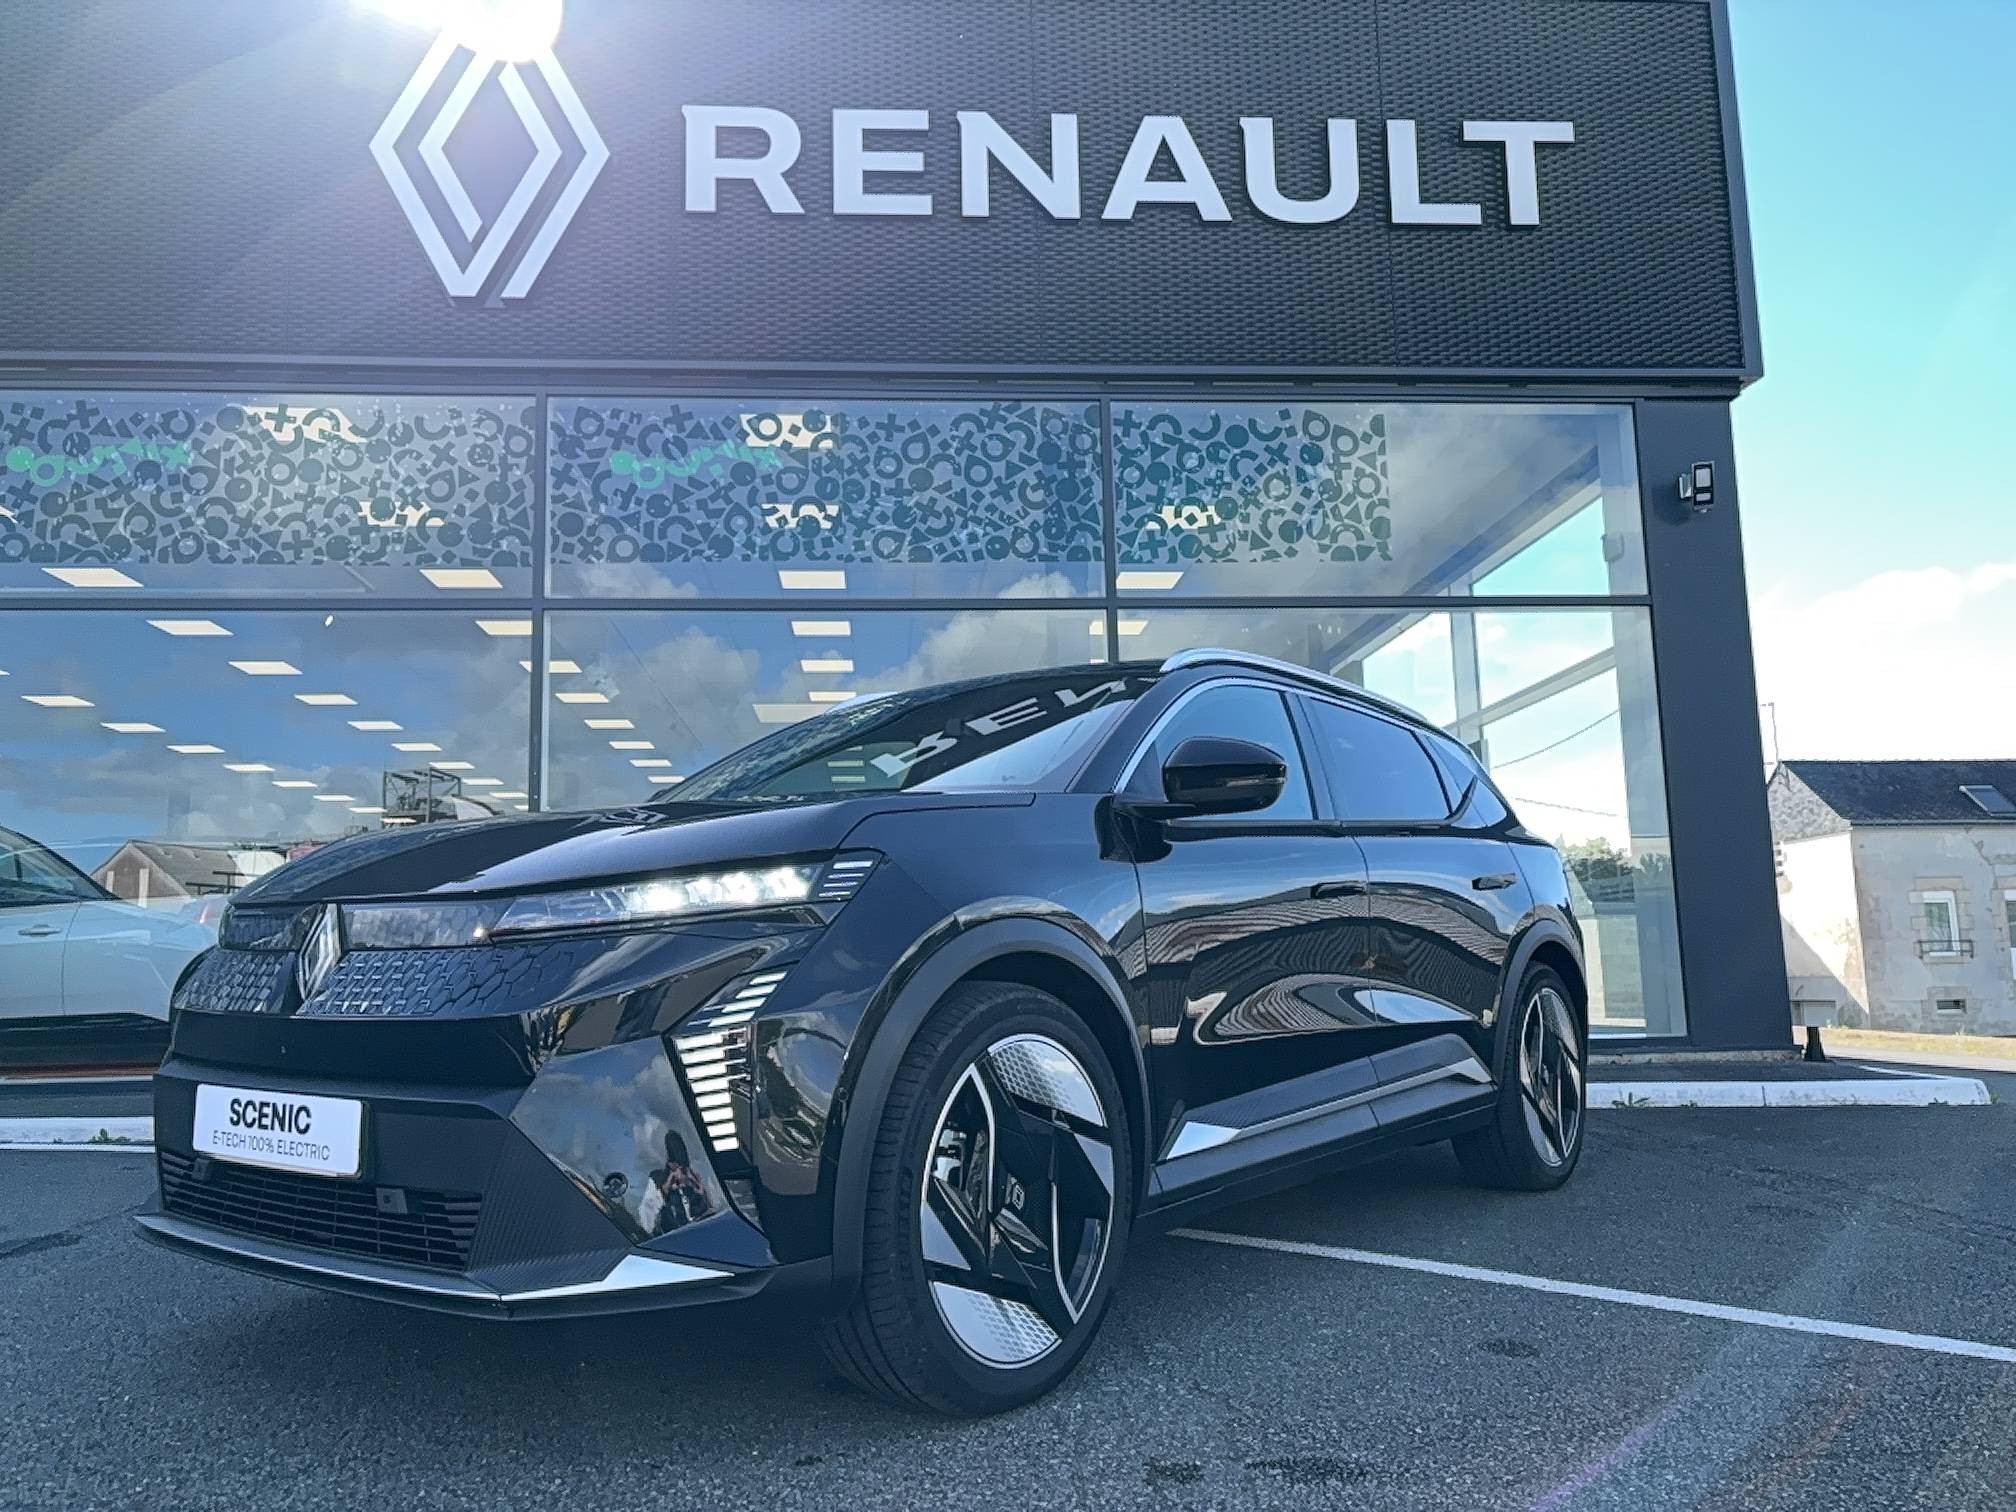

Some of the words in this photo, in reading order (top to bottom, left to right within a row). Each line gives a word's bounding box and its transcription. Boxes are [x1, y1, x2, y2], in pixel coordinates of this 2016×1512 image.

[682, 105, 1575, 227] RENAULT
[229, 1098, 312, 1135] SCENIC
[212, 1129, 246, 1149] E-TECH
[247, 1134, 275, 1154] 100%
[276, 1139, 331, 1161] ELECTRIC
